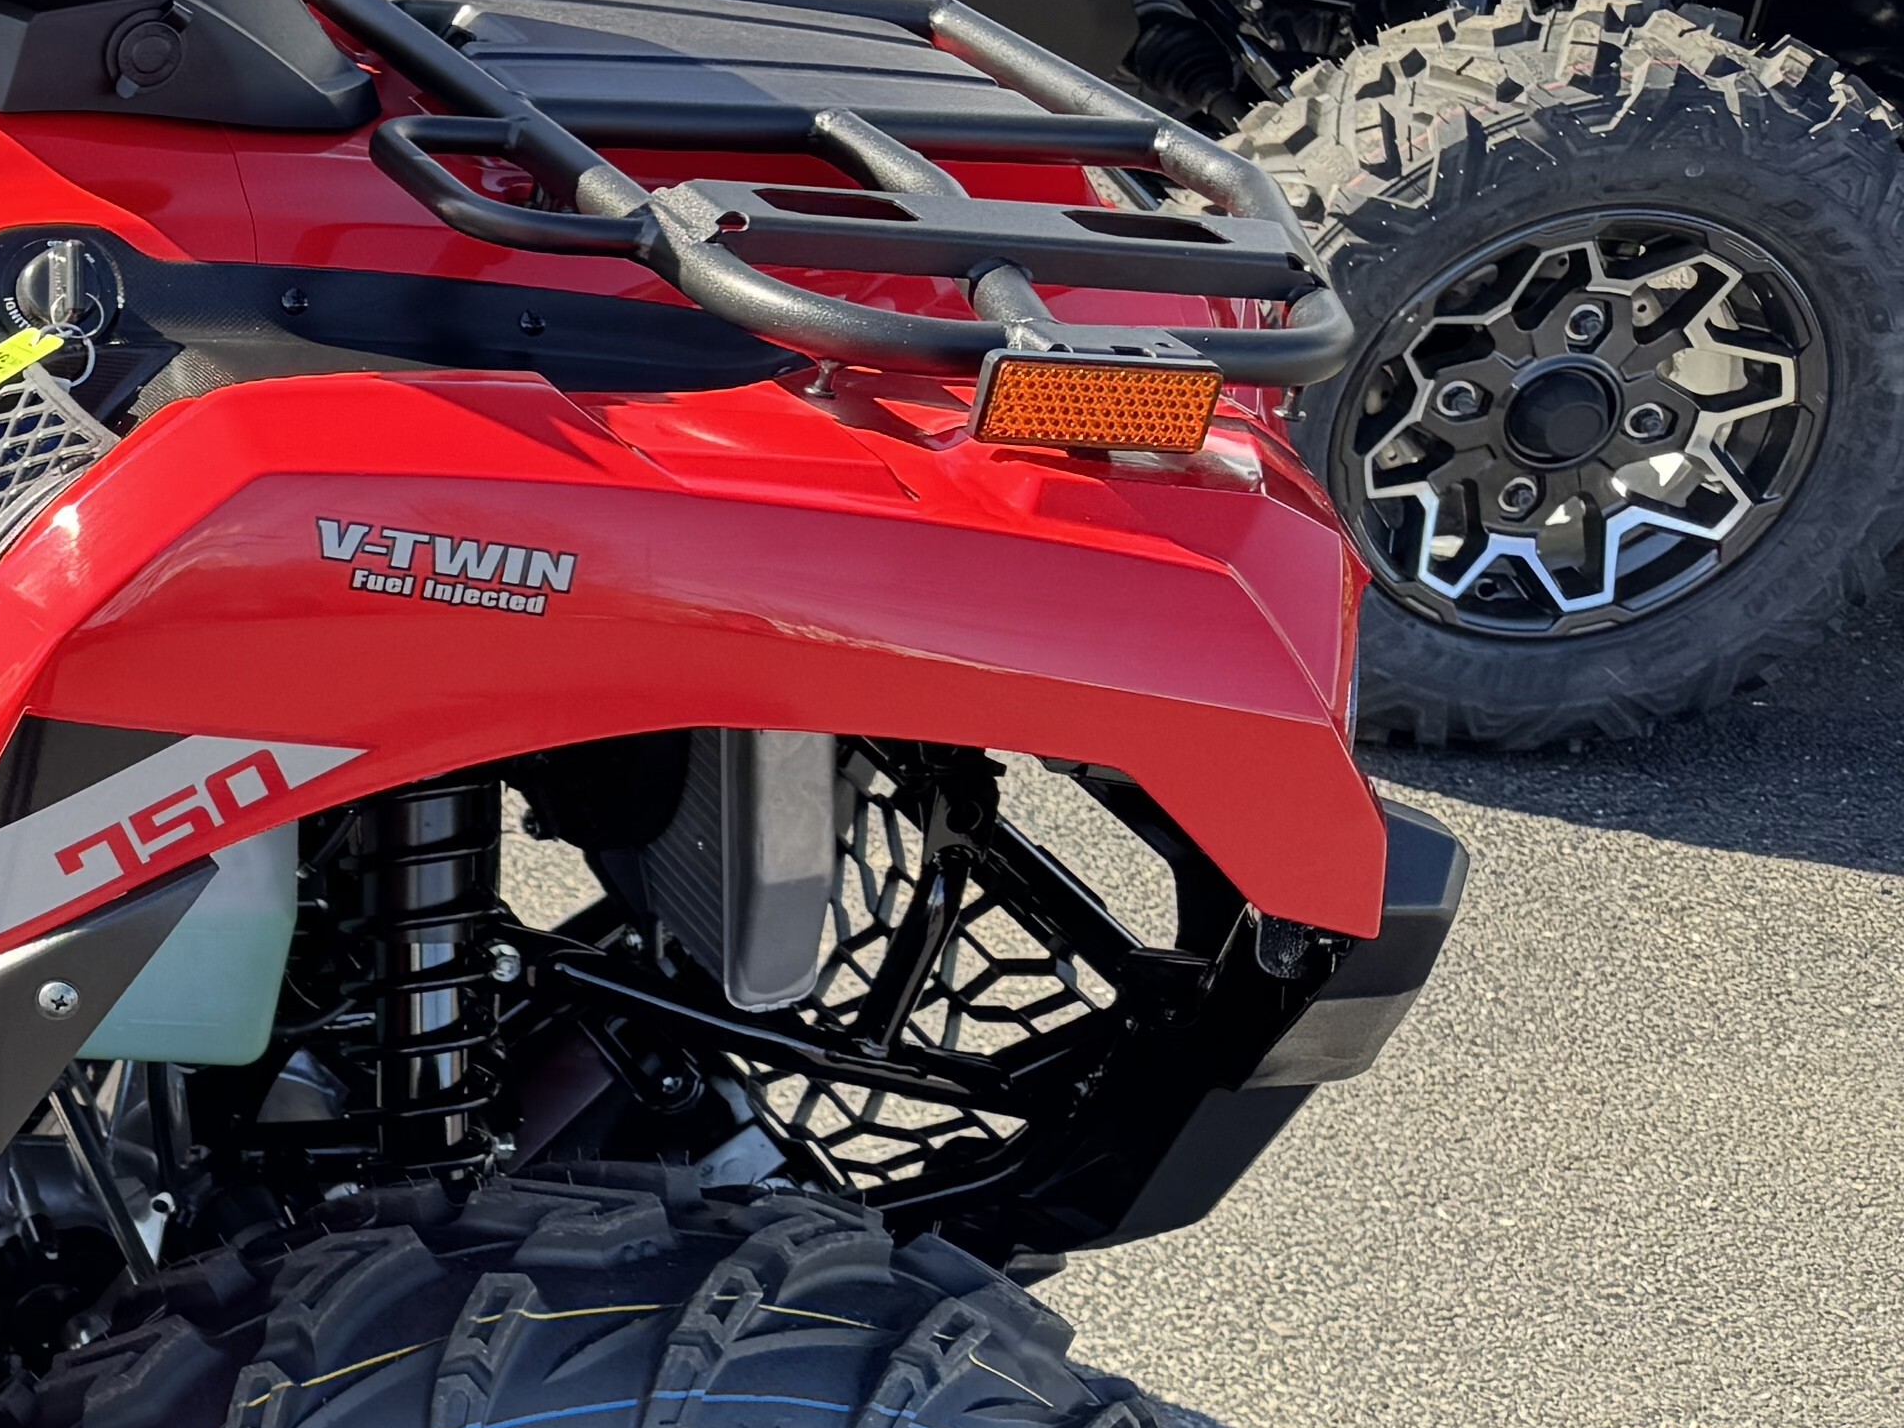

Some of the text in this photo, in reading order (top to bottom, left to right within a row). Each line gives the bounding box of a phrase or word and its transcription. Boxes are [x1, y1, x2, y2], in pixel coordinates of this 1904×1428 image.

[316, 517, 578, 593] V-TWIN
[351, 568, 547, 615] Fuel Injected
[54, 749, 291, 875] 750
